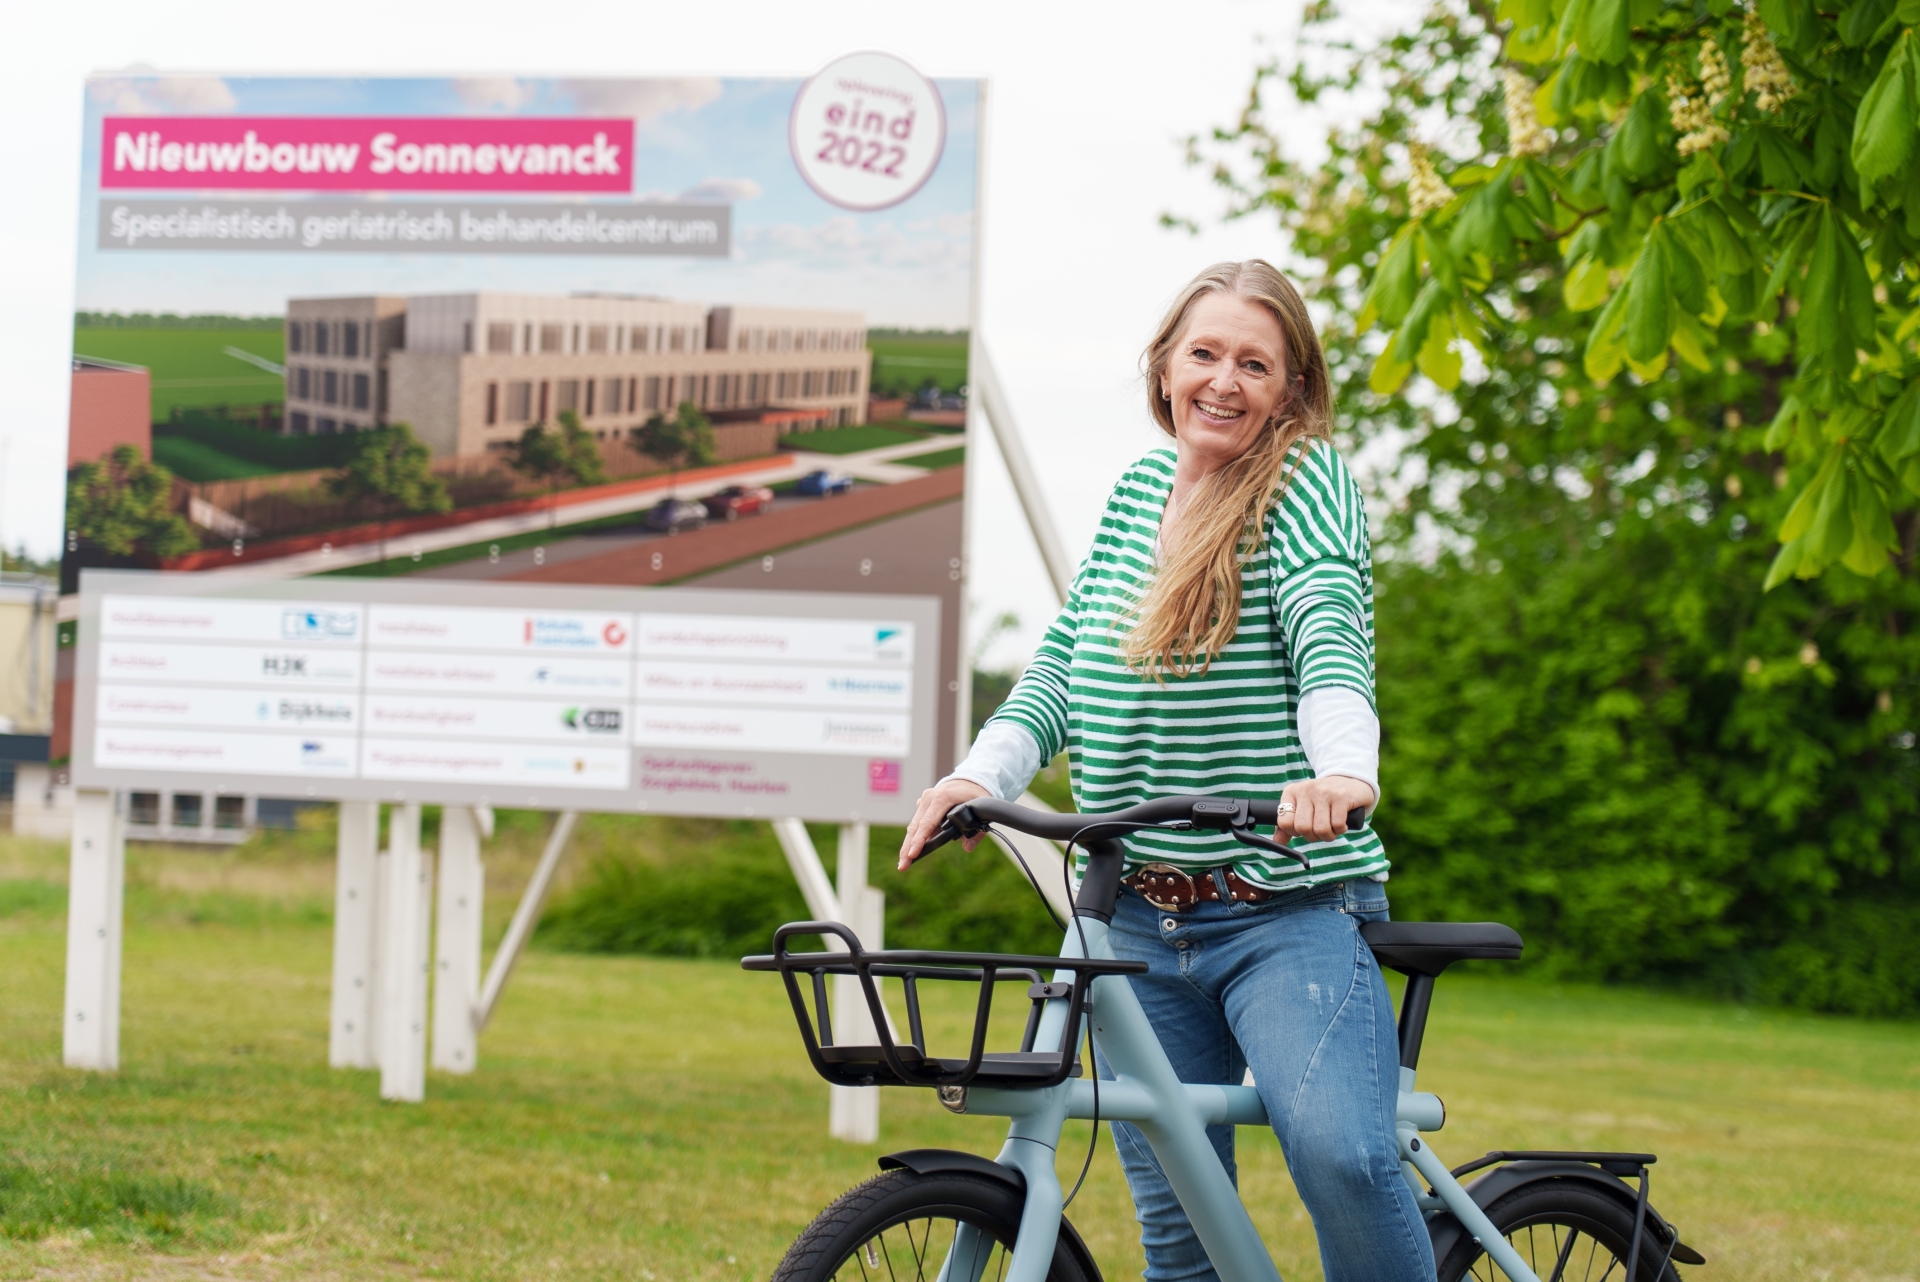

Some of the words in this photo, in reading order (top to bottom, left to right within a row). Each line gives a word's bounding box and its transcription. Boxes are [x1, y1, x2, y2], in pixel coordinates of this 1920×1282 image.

[826, 98, 916, 140] eind
[113, 131, 359, 175] Nieuwbouw
[369, 132, 620, 176] Sonnevanck
[816, 130, 907, 179] 2022
[110, 205, 295, 243] Specialistisch
[302, 208, 452, 246] geriatrisch
[461, 209, 717, 243] behandelcentrum
